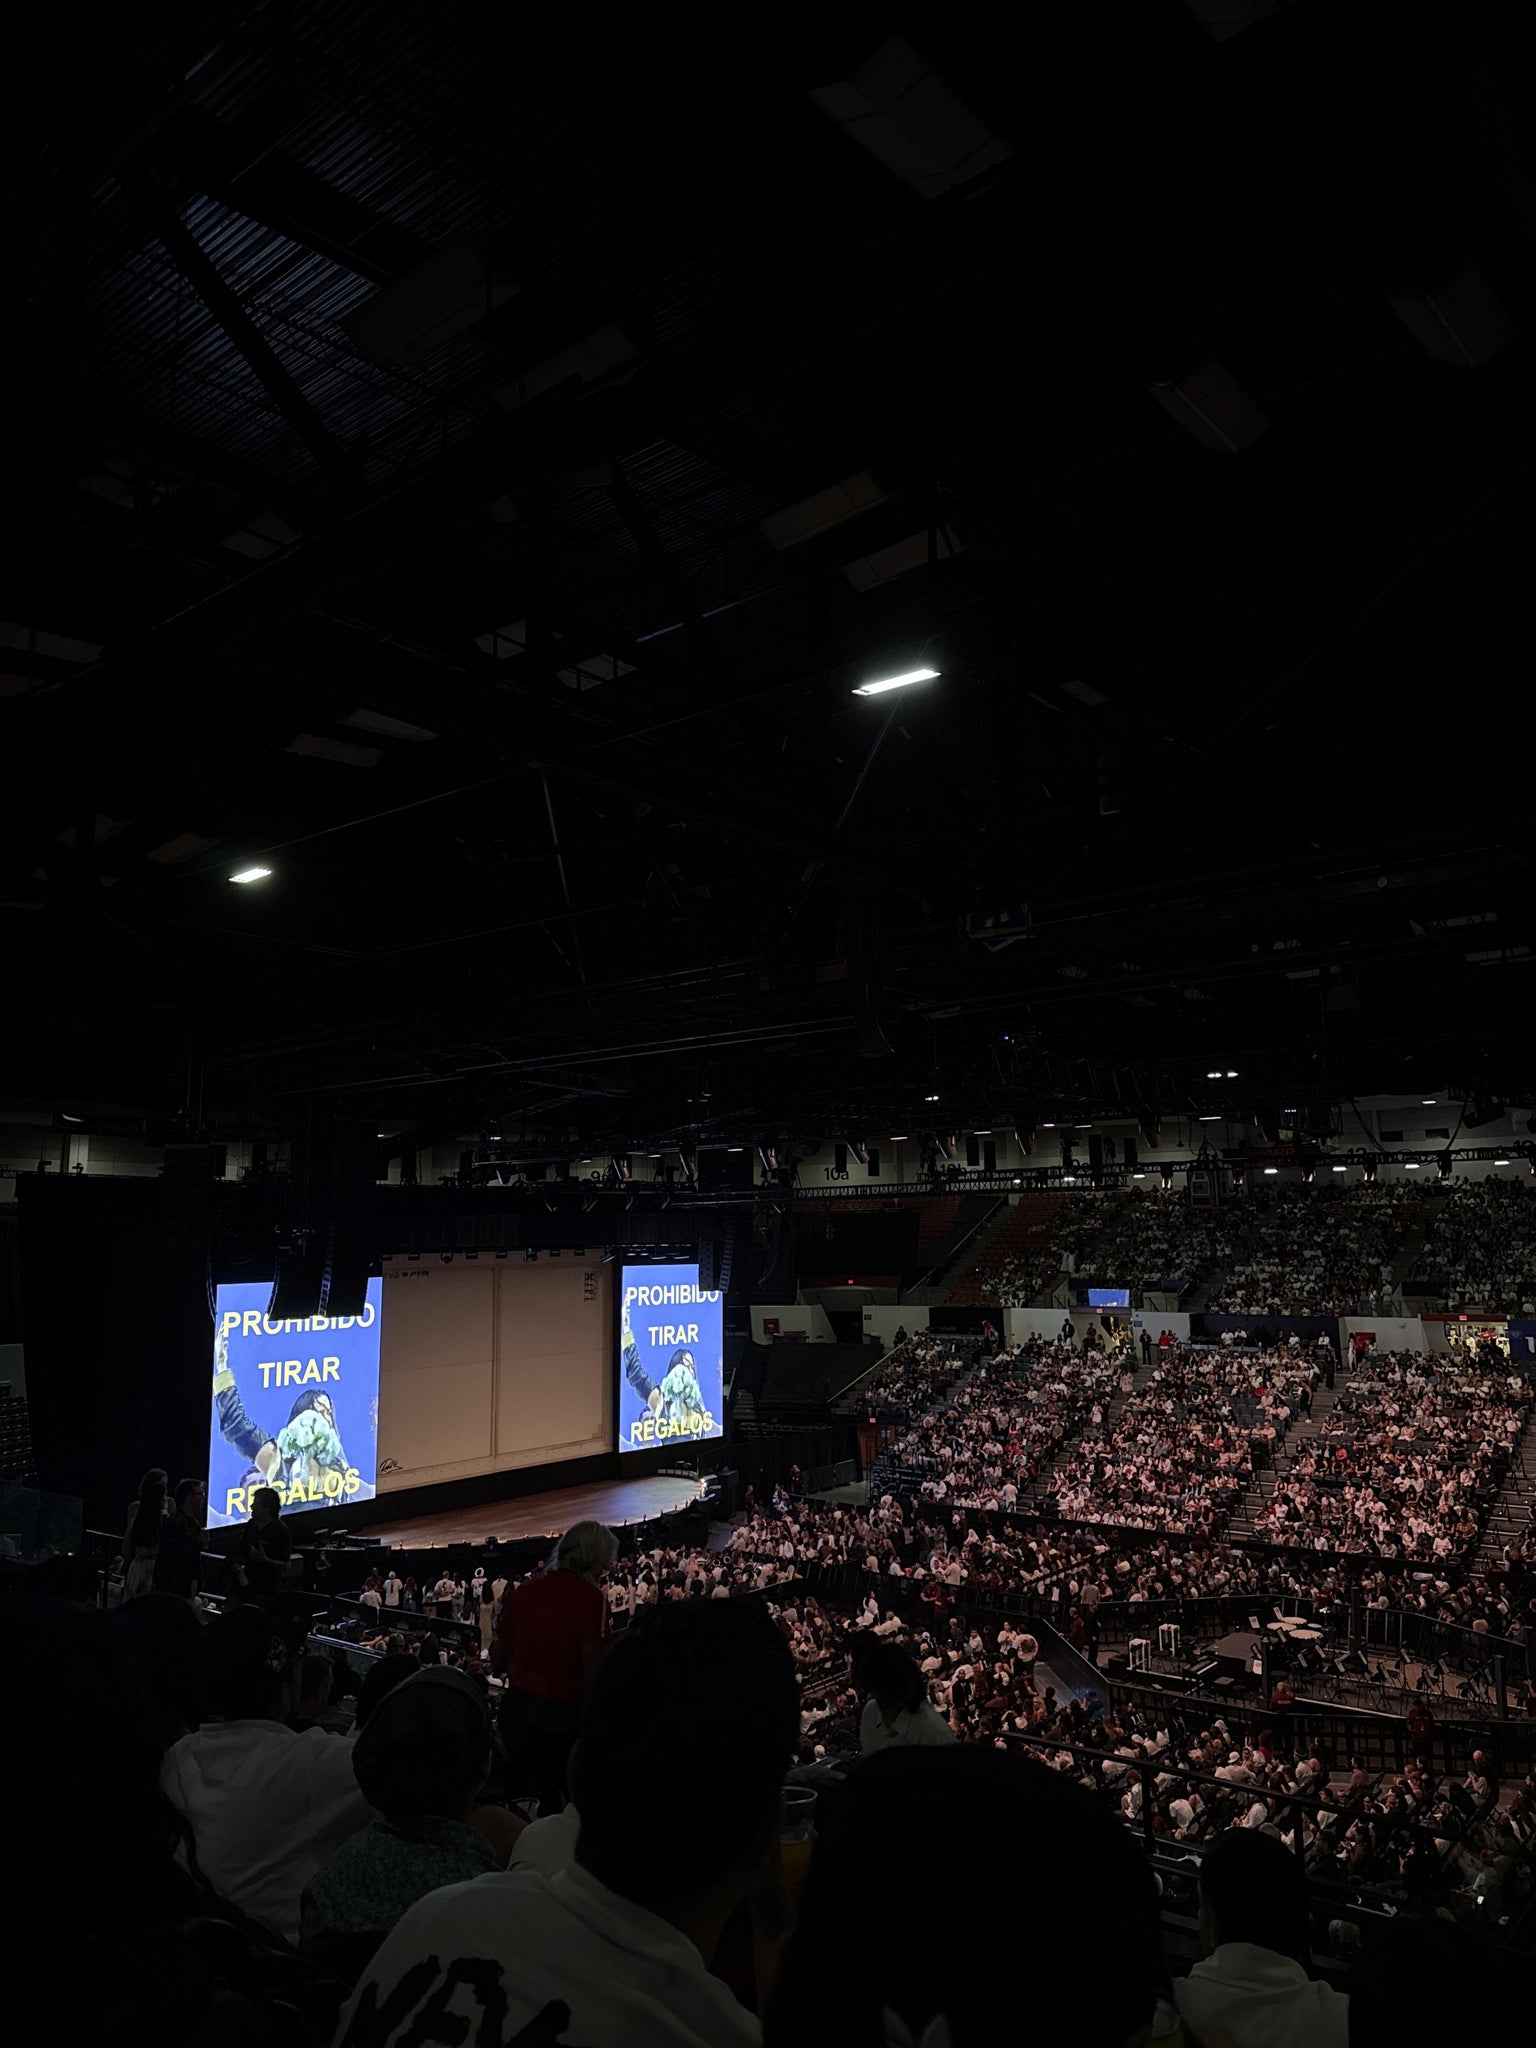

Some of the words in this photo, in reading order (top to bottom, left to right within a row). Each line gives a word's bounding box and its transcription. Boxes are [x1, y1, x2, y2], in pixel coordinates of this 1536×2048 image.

[626, 1284, 719, 1307] PROHIBIDO
[648, 1323, 699, 1347] TIRAR
[258, 1356, 341, 1389] TIRAR
[630, 1411, 714, 1443] REGALOS
